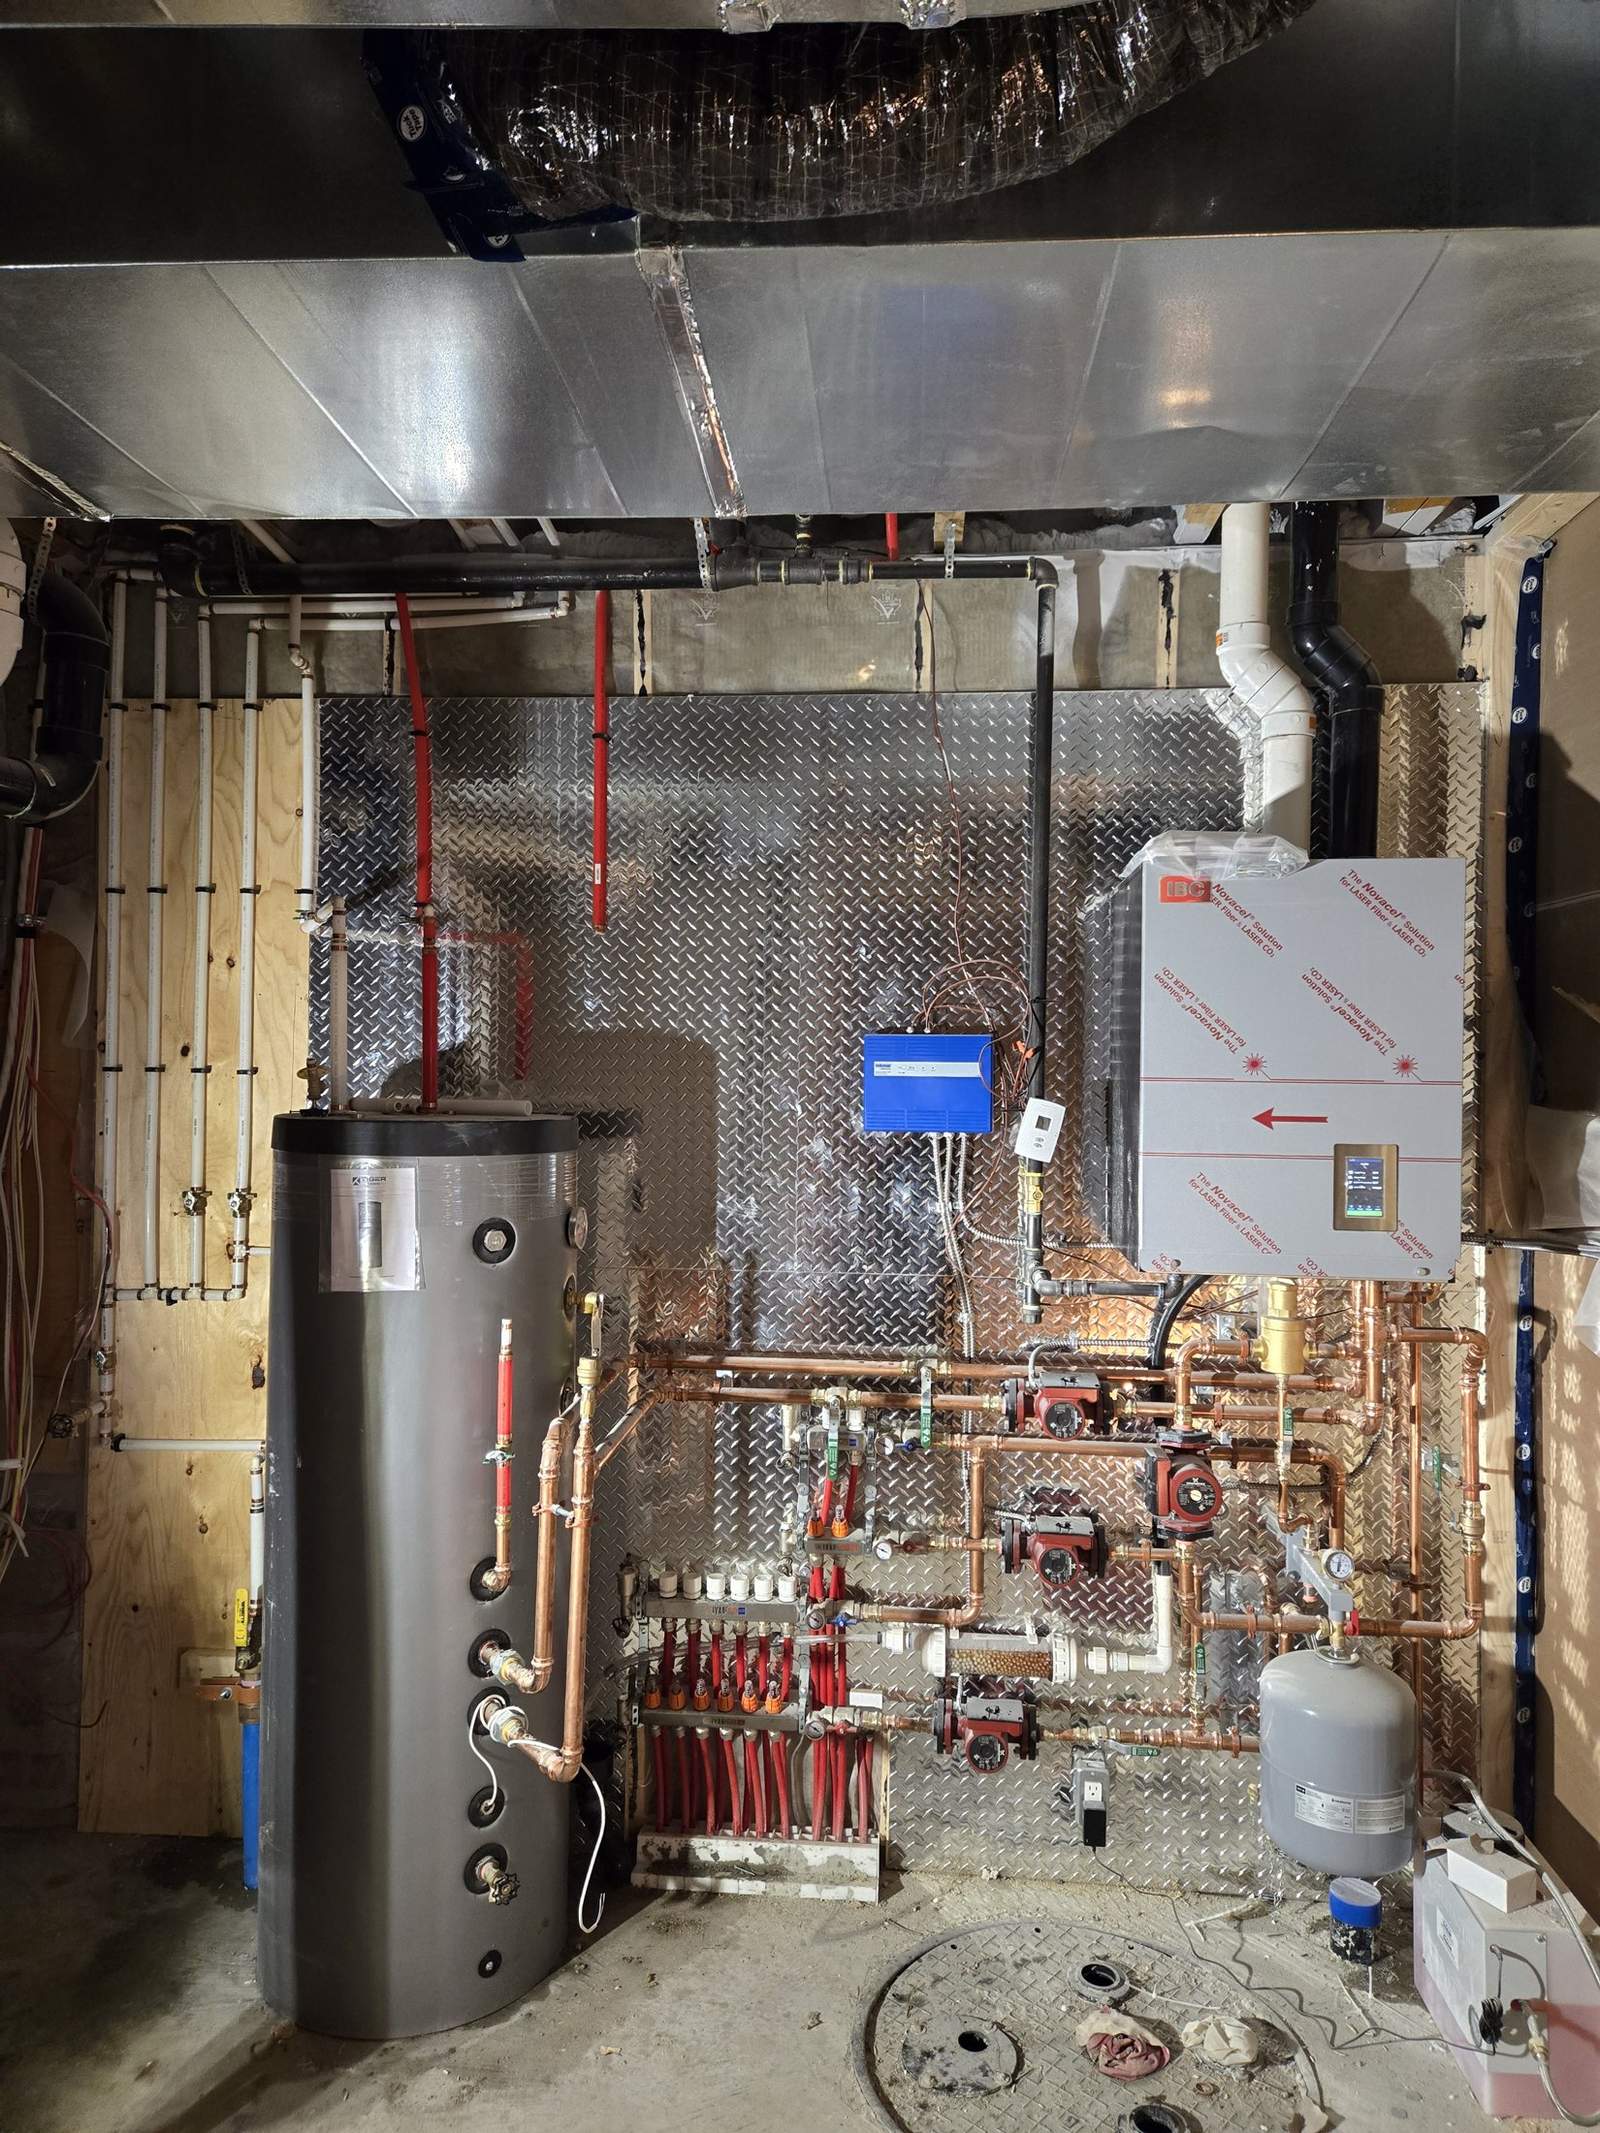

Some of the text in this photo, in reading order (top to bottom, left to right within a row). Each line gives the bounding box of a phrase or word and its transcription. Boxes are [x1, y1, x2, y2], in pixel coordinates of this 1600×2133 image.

[1166, 881, 1206, 898] IBC
[1221, 905, 1238, 922] Fiber
[1241, 924, 1264, 946] LASER
[1349, 886, 1372, 907] LASER
[1370, 905, 1389, 922] Fiber
[1392, 925, 1415, 946] LASER
[1252, 921, 1283, 951] Solution
[1404, 921, 1435, 951] Solution
[1154, 973, 1183, 1003] Solution
[1173, 978, 1195, 1000] LASER
[1302, 974, 1332, 1004] Solution
[1322, 979, 1344, 1000] LASER
[1214, 1016, 1237, 1038] LASER
[1364, 1018, 1387, 1039] LASER
[1199, 1188, 1221, 1209] LASER
[1219, 1207, 1237, 1224] Fiber
[1240, 1227, 1262, 1249] LASER
[1252, 1224, 1281, 1254] Solution
[1402, 1229, 1433, 1259] Solution
